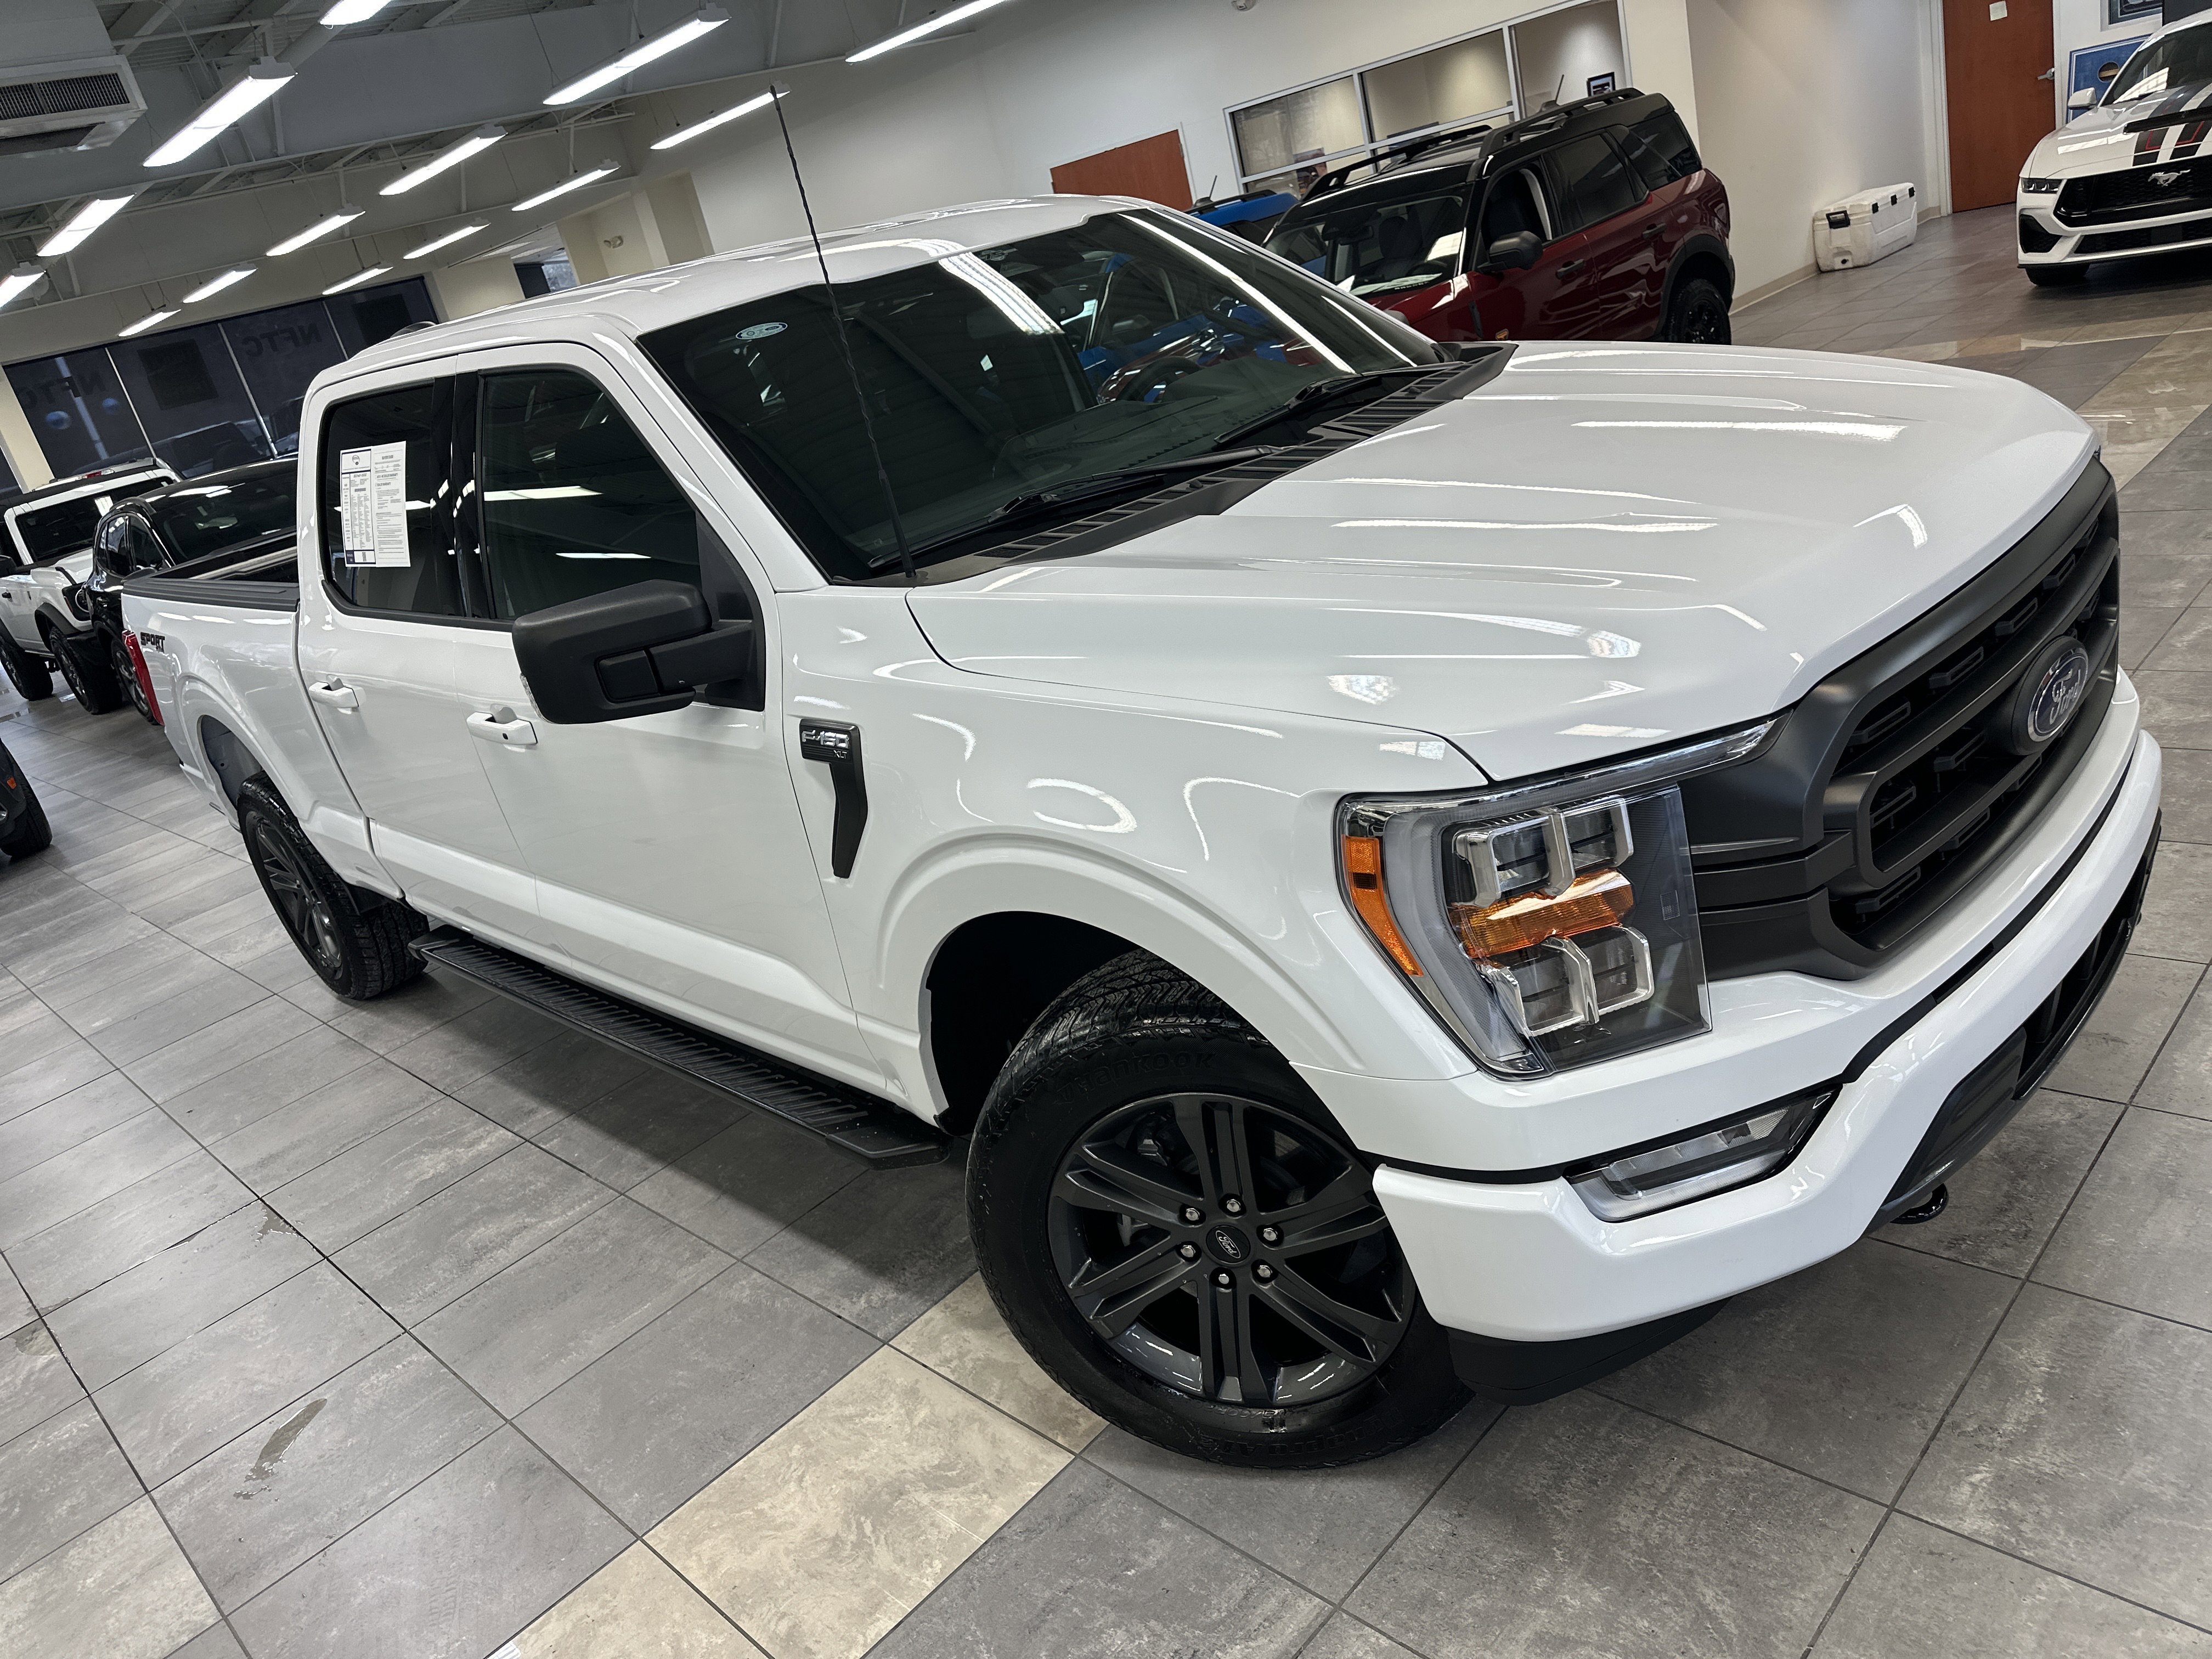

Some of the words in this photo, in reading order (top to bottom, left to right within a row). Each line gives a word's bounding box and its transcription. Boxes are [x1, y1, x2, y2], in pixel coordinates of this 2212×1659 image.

[140, 632, 165, 653] SPORT
[801, 730, 850, 749] F-150
[833, 750, 847, 759] XLT
[1218, 1237, 1237, 1254] Ford
